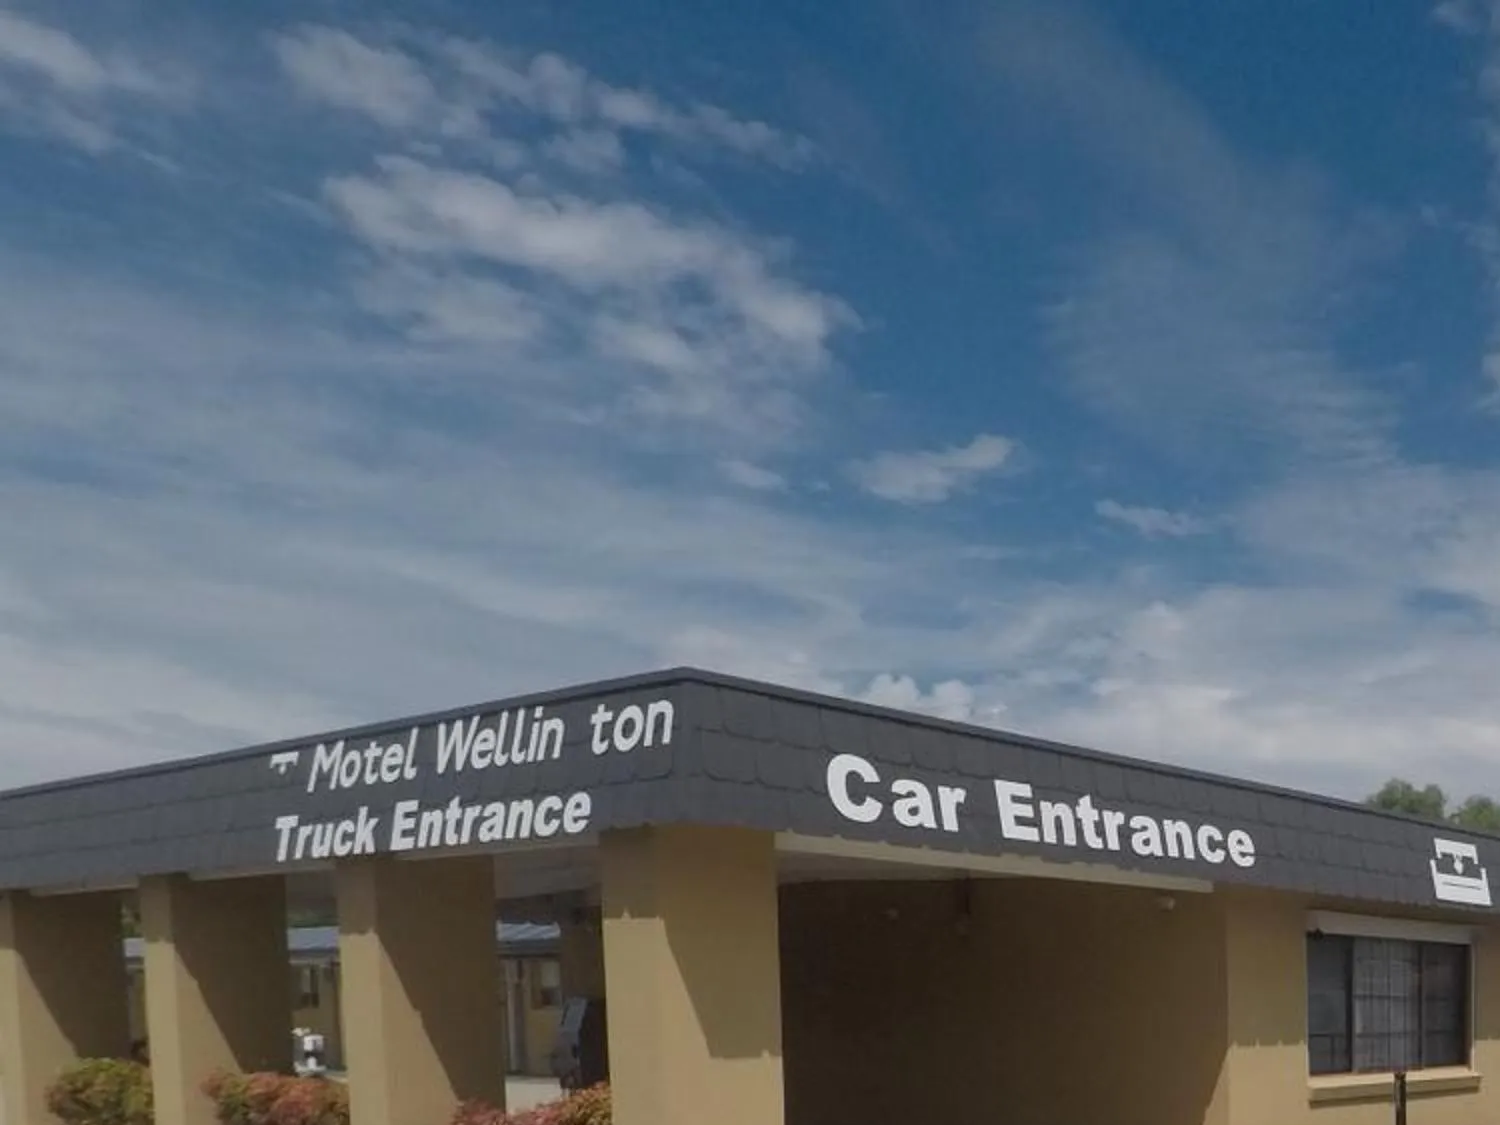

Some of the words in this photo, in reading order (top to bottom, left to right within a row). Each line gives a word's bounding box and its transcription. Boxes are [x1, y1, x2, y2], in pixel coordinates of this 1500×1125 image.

[306, 728, 418, 793] Motel
[274, 806, 379, 864] Truck
[388, 791, 593, 853] Entrance
[825, 752, 967, 834] Car
[993, 778, 1257, 868] Entrance
